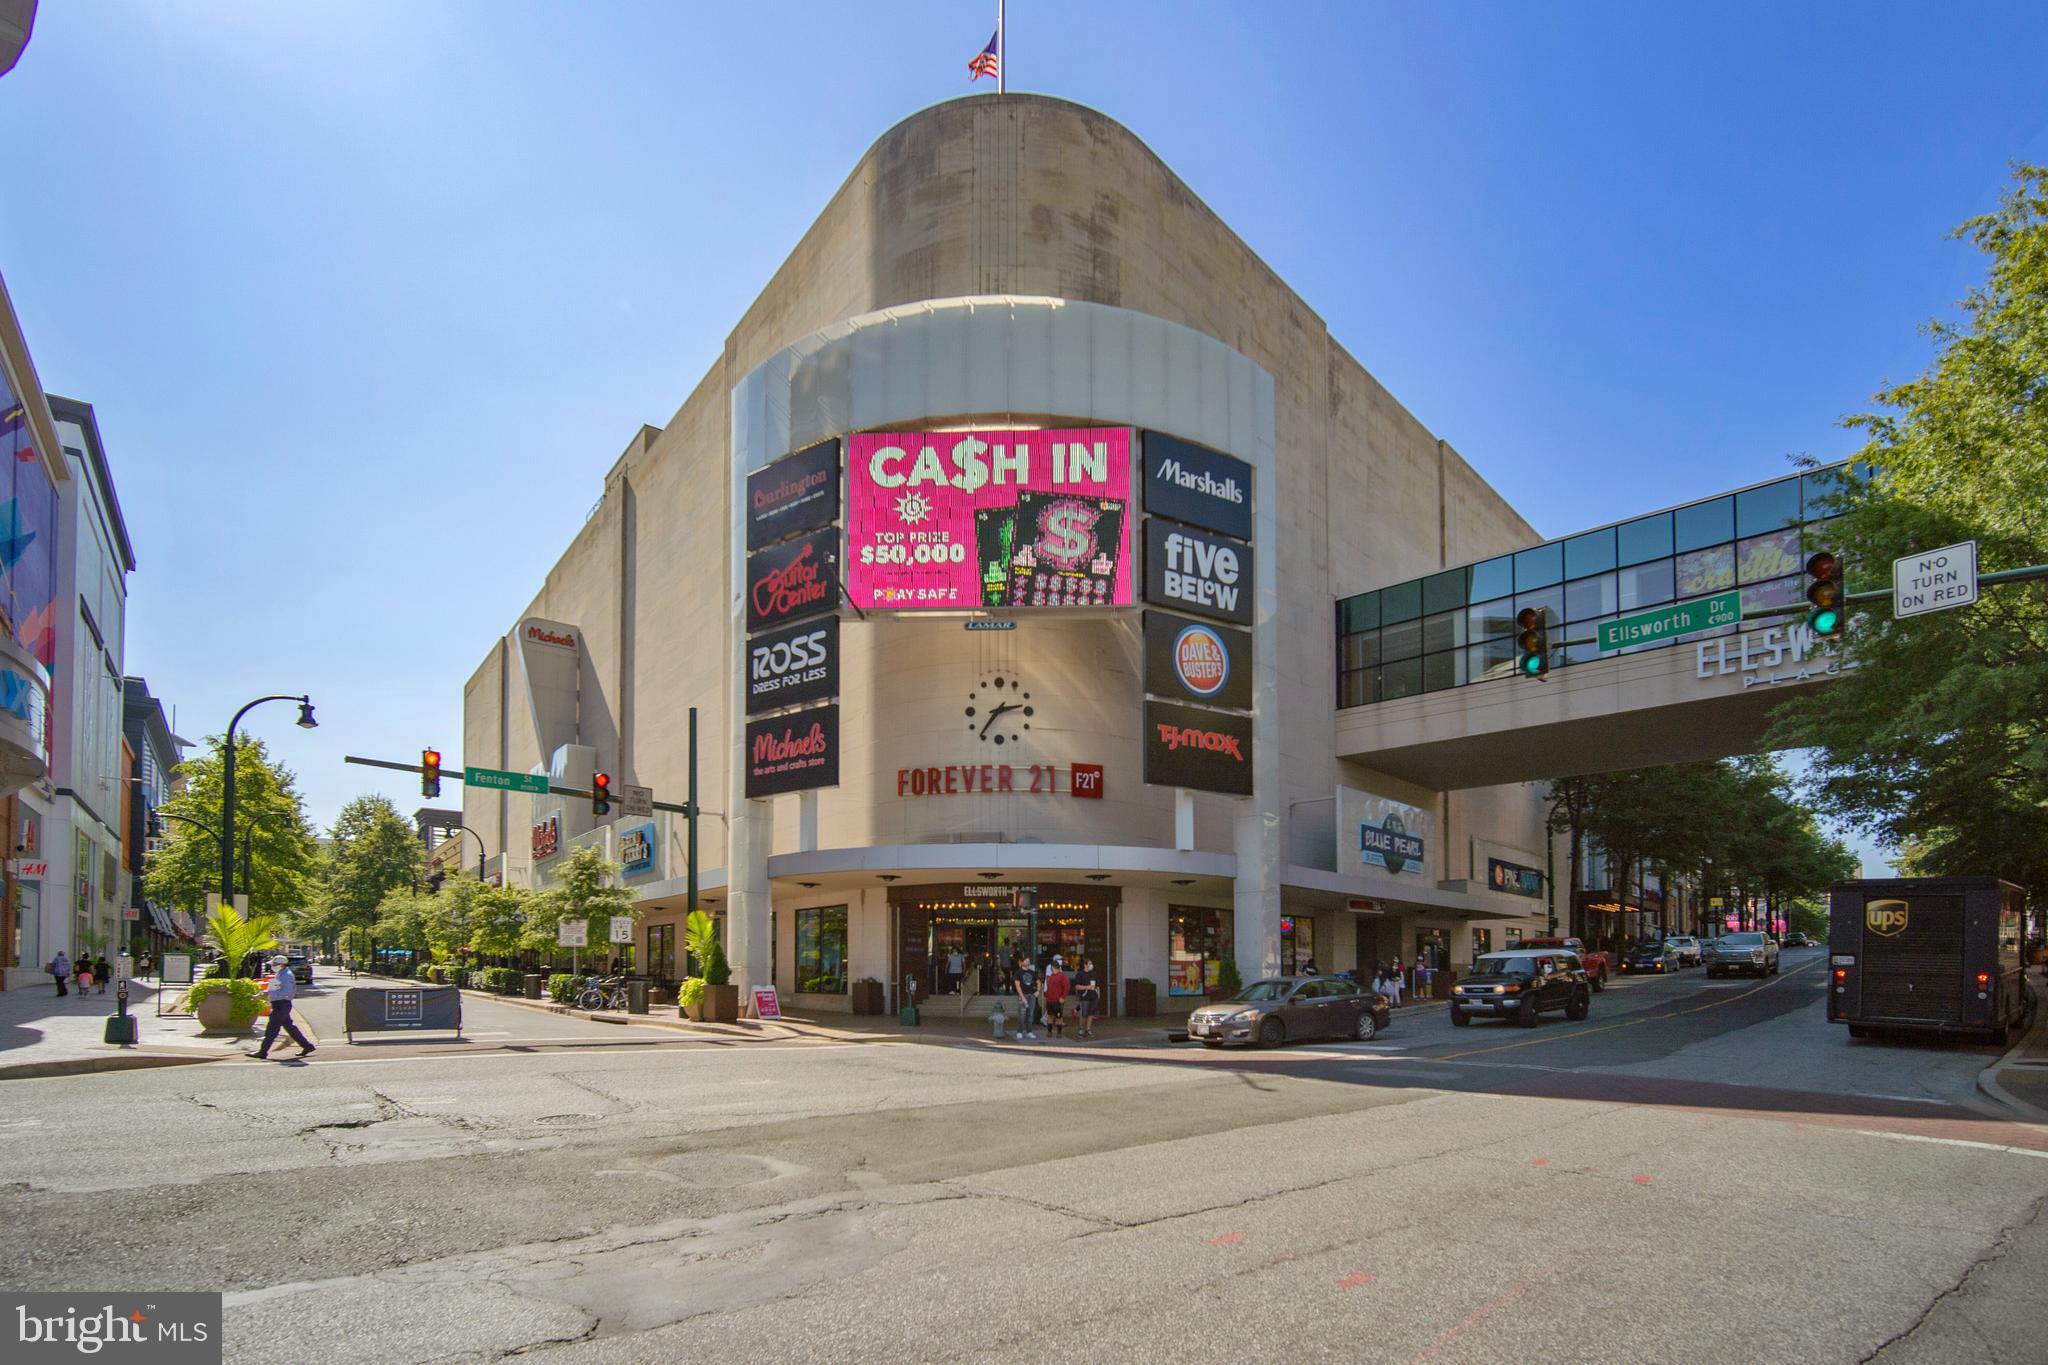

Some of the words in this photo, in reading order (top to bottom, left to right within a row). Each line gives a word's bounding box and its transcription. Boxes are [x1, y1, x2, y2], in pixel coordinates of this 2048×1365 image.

[869, 435, 1028, 493] CA$H
[1052, 442, 1107, 484] IN
[1157, 458, 1243, 504] Marshalls
[875, 532, 904, 543] TOP
[910, 531, 950, 543] PRIZE
[860, 543, 965, 566] $50,000
[1919, 556, 1948, 573] NO
[1912, 570, 1957, 590] TURN
[776, 579, 827, 613] Center
[874, 588, 915, 600] PAY
[918, 588, 958, 600] SAFE
[1902, 594, 1924, 608] ON
[1934, 584, 1968, 602] RED
[968, 622, 1012, 630] LAMAR
[1608, 611, 1691, 643] Ellsworth
[1710, 600, 1726, 614] Dr
[753, 630, 826, 680] ROSS
[1182, 642, 1211, 661] DAVE
[1697, 617, 1872, 678] ELLSW
[753, 678, 780, 694] DRESS
[782, 674, 801, 687] FOR
[803, 667, 827, 682] LESS
[1743, 661, 1843, 689] PLAC
[753, 722, 827, 764] Michaels
[475, 772, 511, 786] Fenton
[897, 764, 1013, 797] FOREVER
[1028, 764, 1056, 794] 21
[1365, 829, 1391, 850] BLUE
[1394, 836, 1421, 857] PEARL
[963, 885, 1007, 897] ELLSWORTH
[1870, 911, 1905, 931] ups
[616, 930, 629, 940] 15
